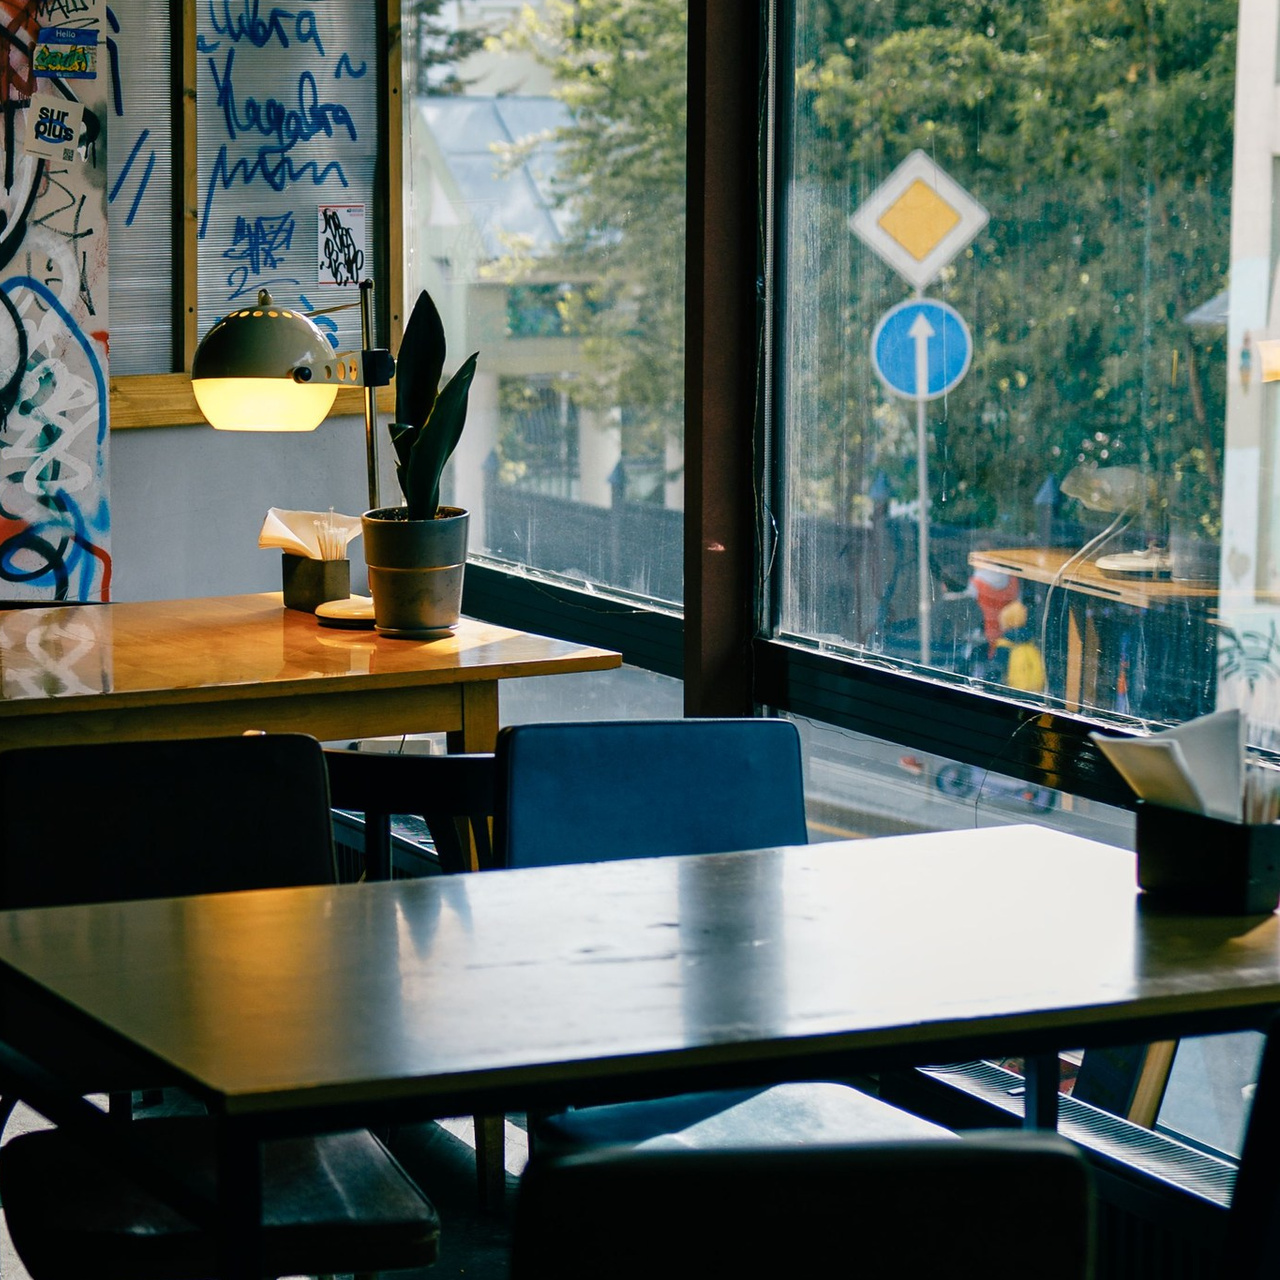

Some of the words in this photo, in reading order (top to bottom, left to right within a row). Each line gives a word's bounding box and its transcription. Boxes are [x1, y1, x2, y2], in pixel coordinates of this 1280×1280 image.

[55, 29, 77, 39] Hello
[38, 106, 69, 122] sur
[35, 118, 75, 141] plus
